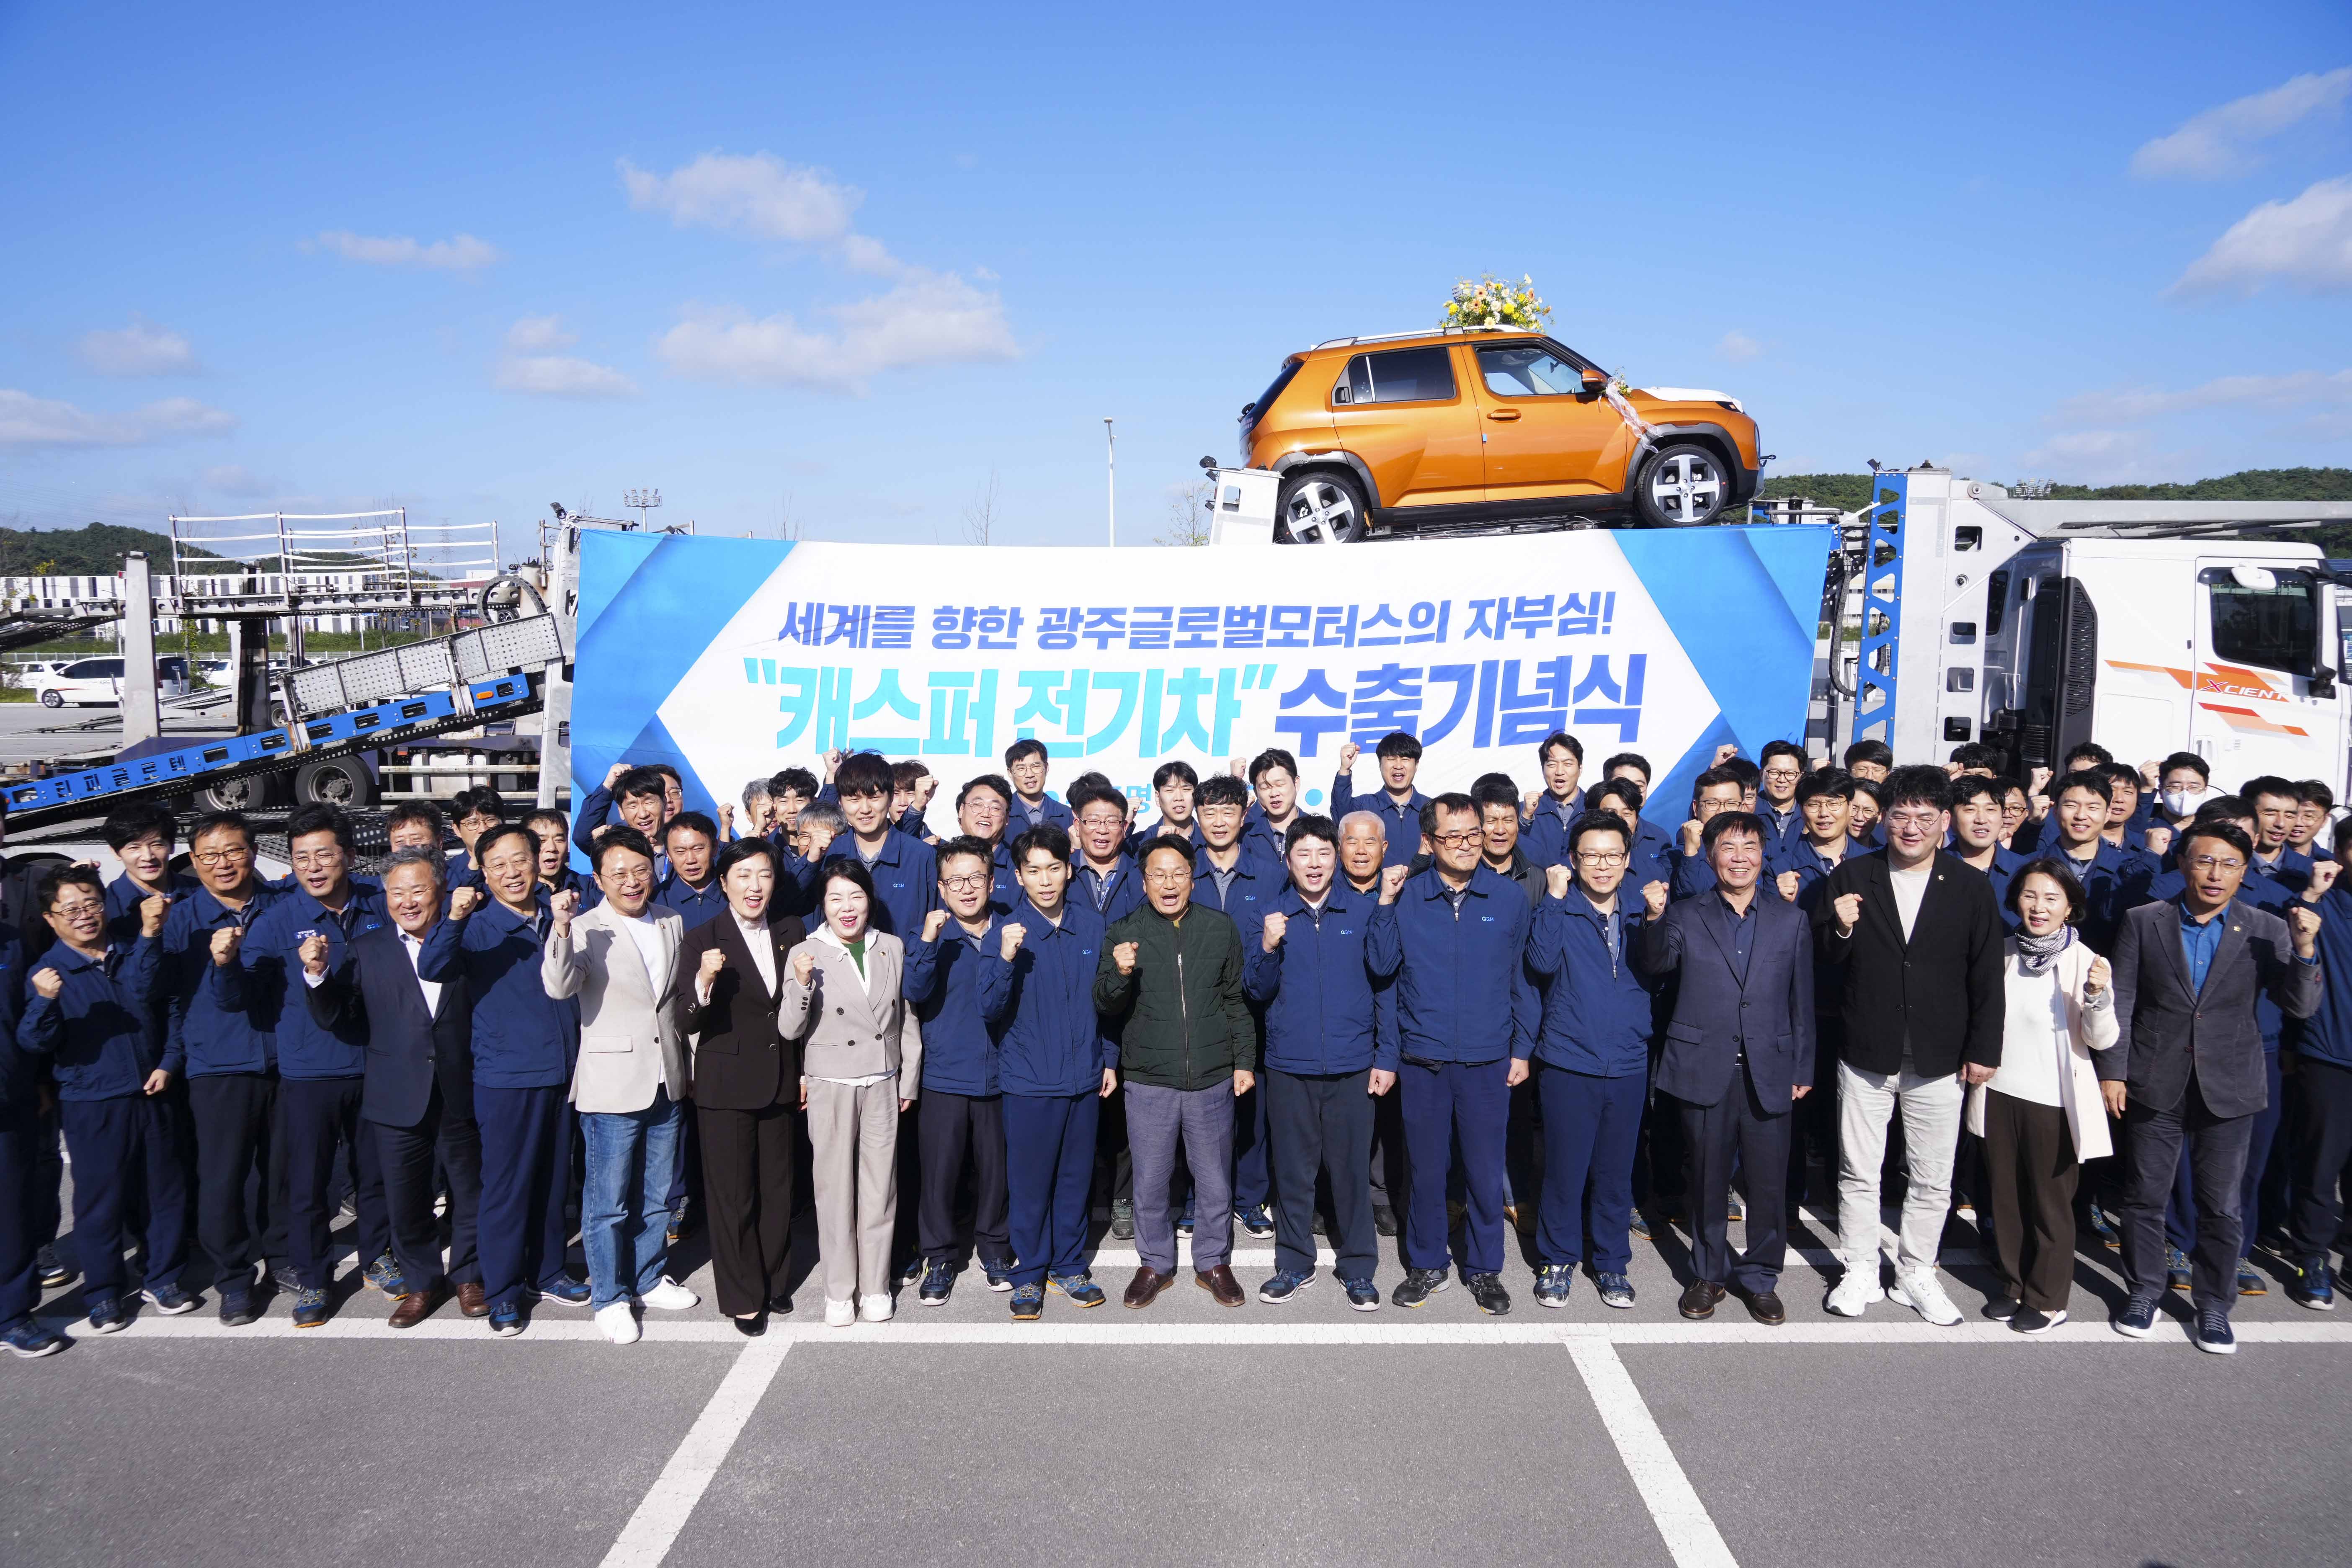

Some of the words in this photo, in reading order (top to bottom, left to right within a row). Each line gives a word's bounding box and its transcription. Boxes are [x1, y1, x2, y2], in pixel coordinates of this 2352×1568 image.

[778, 601, 916, 649] 세계를
[931, 605, 1024, 650] 향한
[1037, 600, 1451, 650] 광주글로벌모터스의
[1464, 591, 1616, 641] 자부심!
[743, 658, 999, 758] "캐스퍼
[1274, 653, 1647, 758] 수출기념식
[2199, 679, 2289, 700] XCIENT
